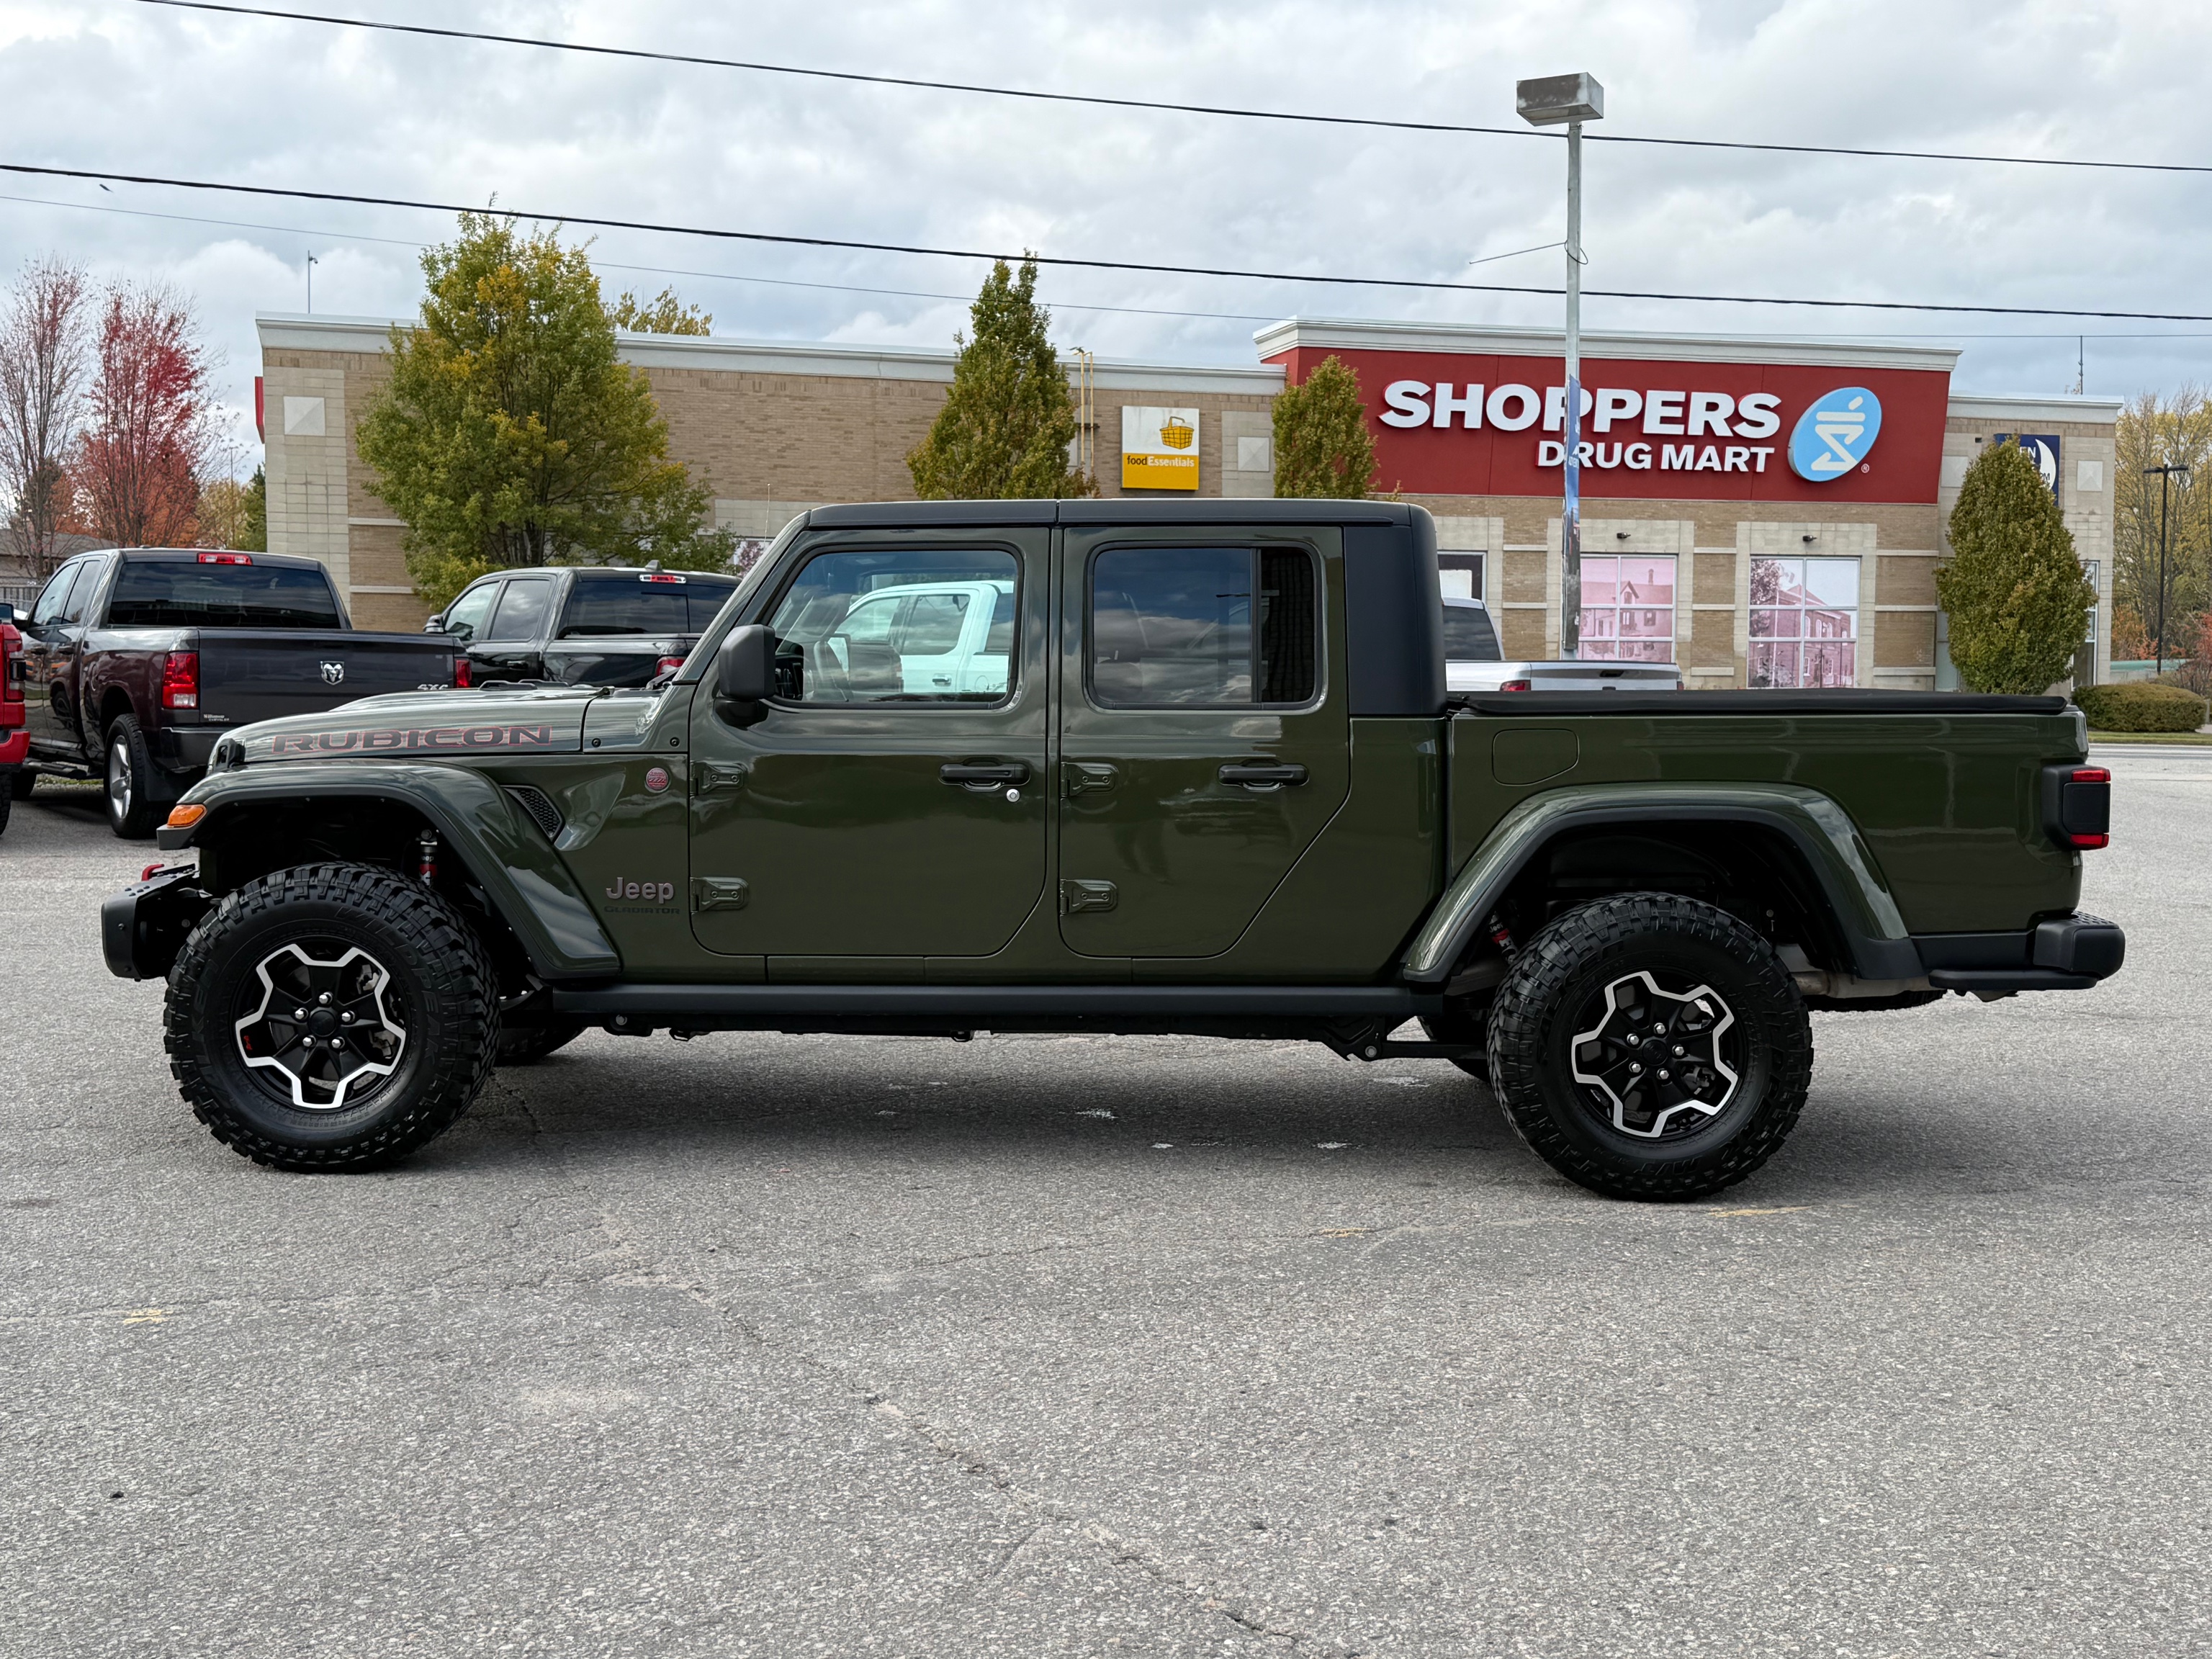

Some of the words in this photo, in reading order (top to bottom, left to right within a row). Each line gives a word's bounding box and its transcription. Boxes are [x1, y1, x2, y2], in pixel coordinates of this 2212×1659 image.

[1378, 379, 1782, 439] SHOPPERS
[1537, 440, 1653, 470] DRUG
[1660, 444, 1775, 473] MART
[271, 726, 552, 754] RUBICON
[606, 876, 674, 904] Jeep
[603, 906, 680, 914] GLADIATOR
